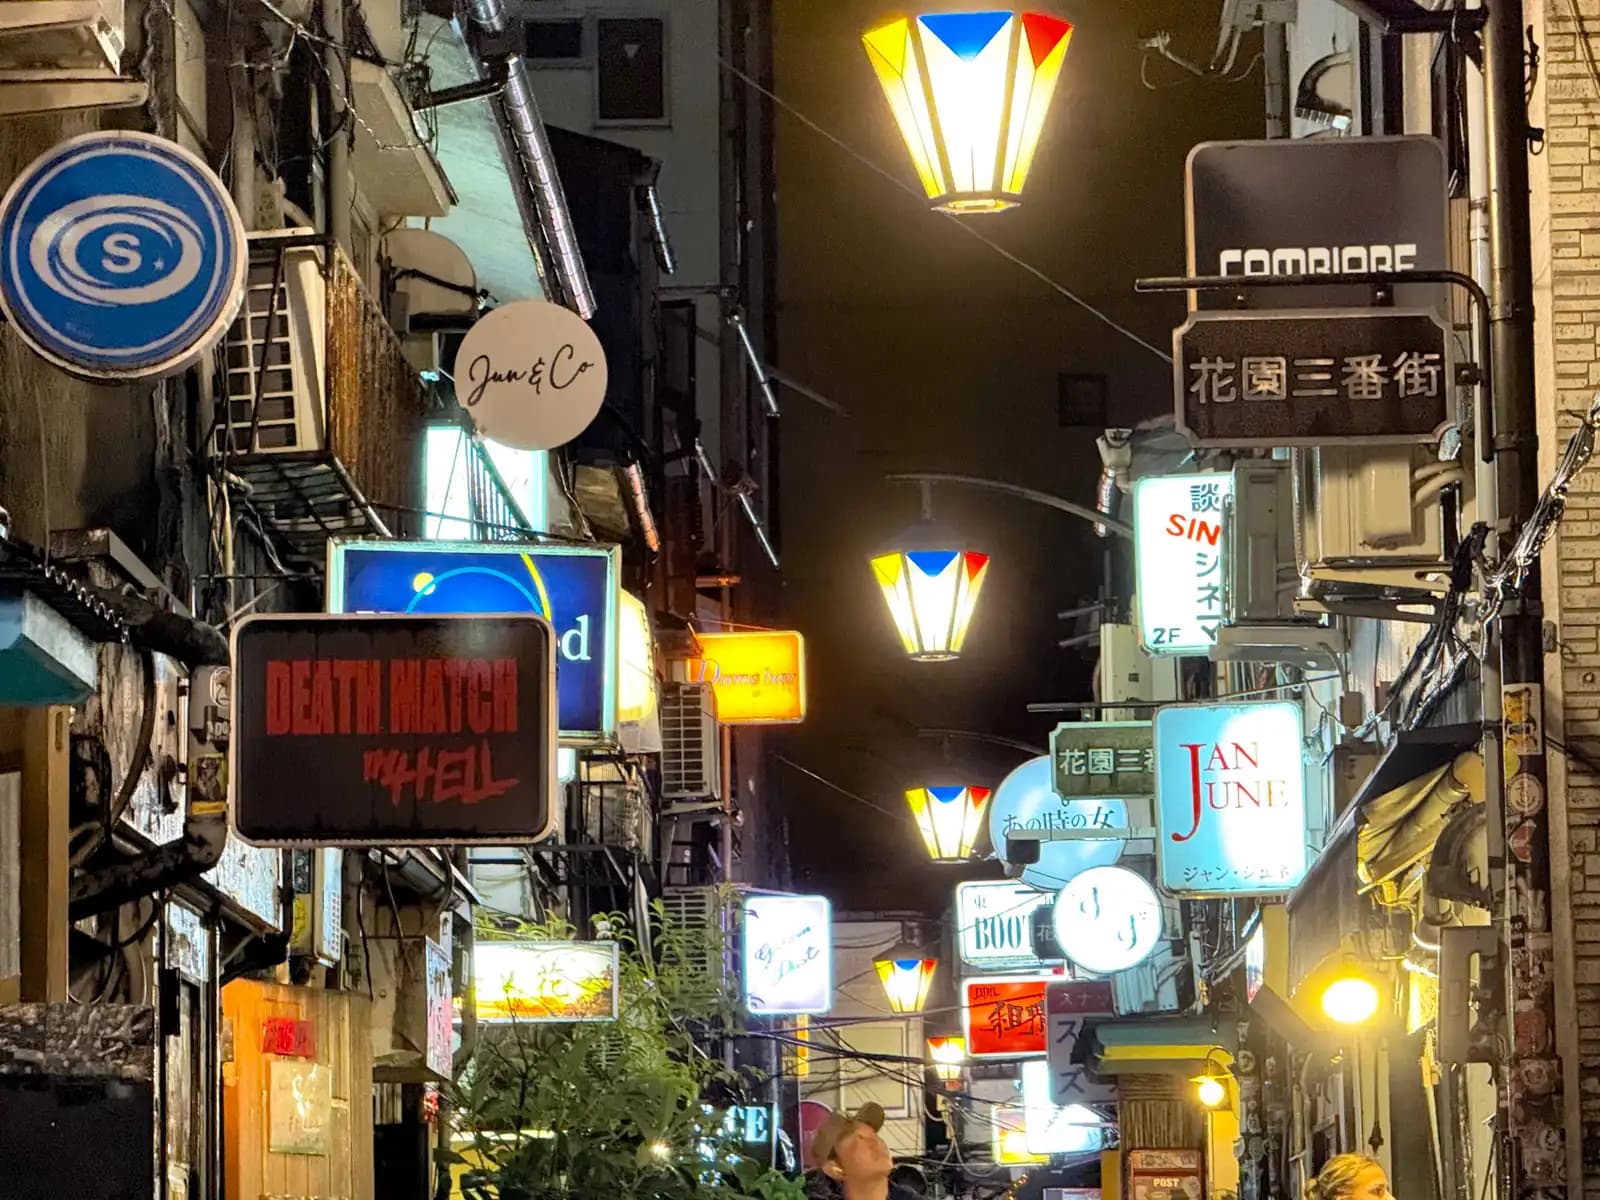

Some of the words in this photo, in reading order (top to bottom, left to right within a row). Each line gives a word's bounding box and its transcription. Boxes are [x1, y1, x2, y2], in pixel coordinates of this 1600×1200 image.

[102, 232, 142, 274] S
[468, 354, 527, 407] Jun
[528, 356, 546, 395] &
[550, 343, 595, 390] Co
[1189, 351, 1442, 404] 花園三番街
[1153, 627, 1182, 645] 2F
[266, 659, 381, 736] DEATH
[389, 657, 518, 734] MATCH
[1152, 1178, 1180, 1188] POST
